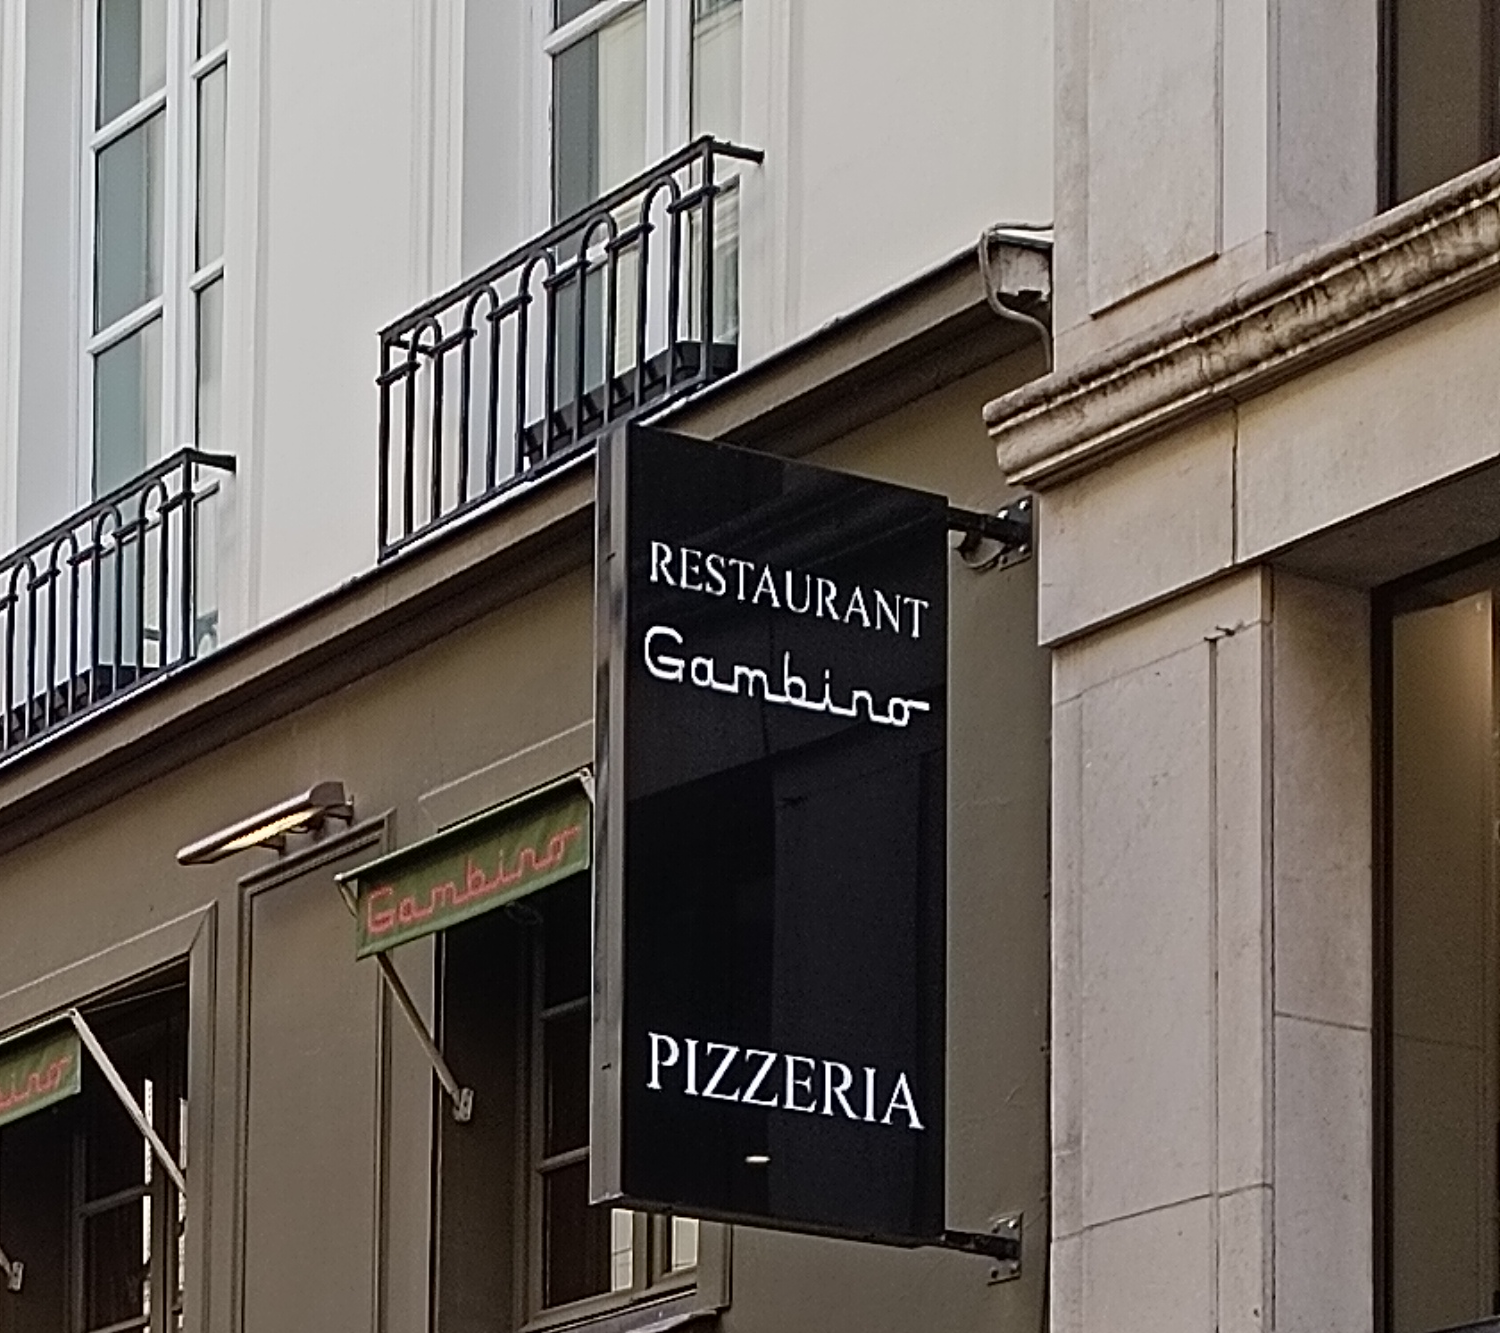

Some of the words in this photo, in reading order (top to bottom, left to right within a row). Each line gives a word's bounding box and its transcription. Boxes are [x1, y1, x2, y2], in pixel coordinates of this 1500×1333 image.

[649, 540, 929, 639] RESTAURANT
[644, 625, 930, 727] Gambino
[367, 831, 581, 935] Gambino
[646, 1031, 925, 1130] PIZZERIA
